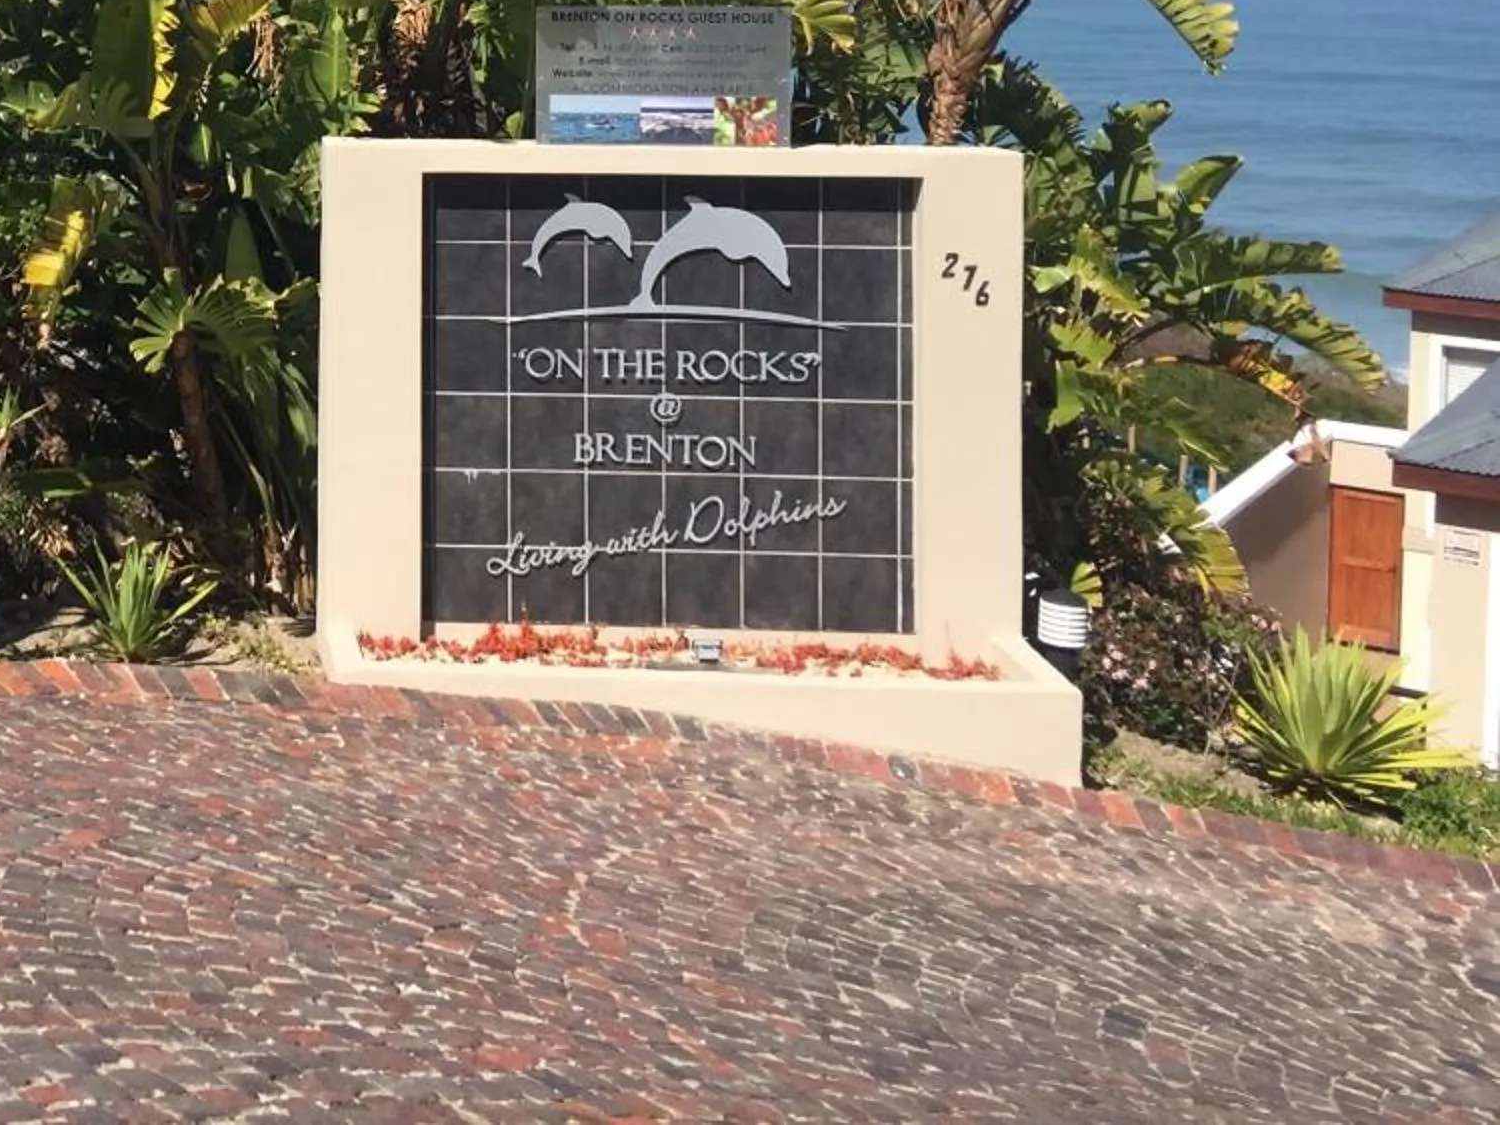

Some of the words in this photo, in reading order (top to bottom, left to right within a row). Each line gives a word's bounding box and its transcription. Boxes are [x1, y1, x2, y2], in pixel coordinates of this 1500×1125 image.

[551, 11, 610, 23] BRENTON
[613, 12, 635, 23] ON
[639, 12, 684, 24] ROCKS
[687, 12, 727, 24] GUEST
[731, 13, 775, 25] HOUSE
[941, 252, 990, 307] 276
[594, 347, 665, 380] THE
[650, 393, 681, 423] @
[574, 433, 756, 467] BRENTON
[486, 531, 600, 576] Living
[606, 510, 679, 556] with
[683, 490, 847, 547] Dolphins
